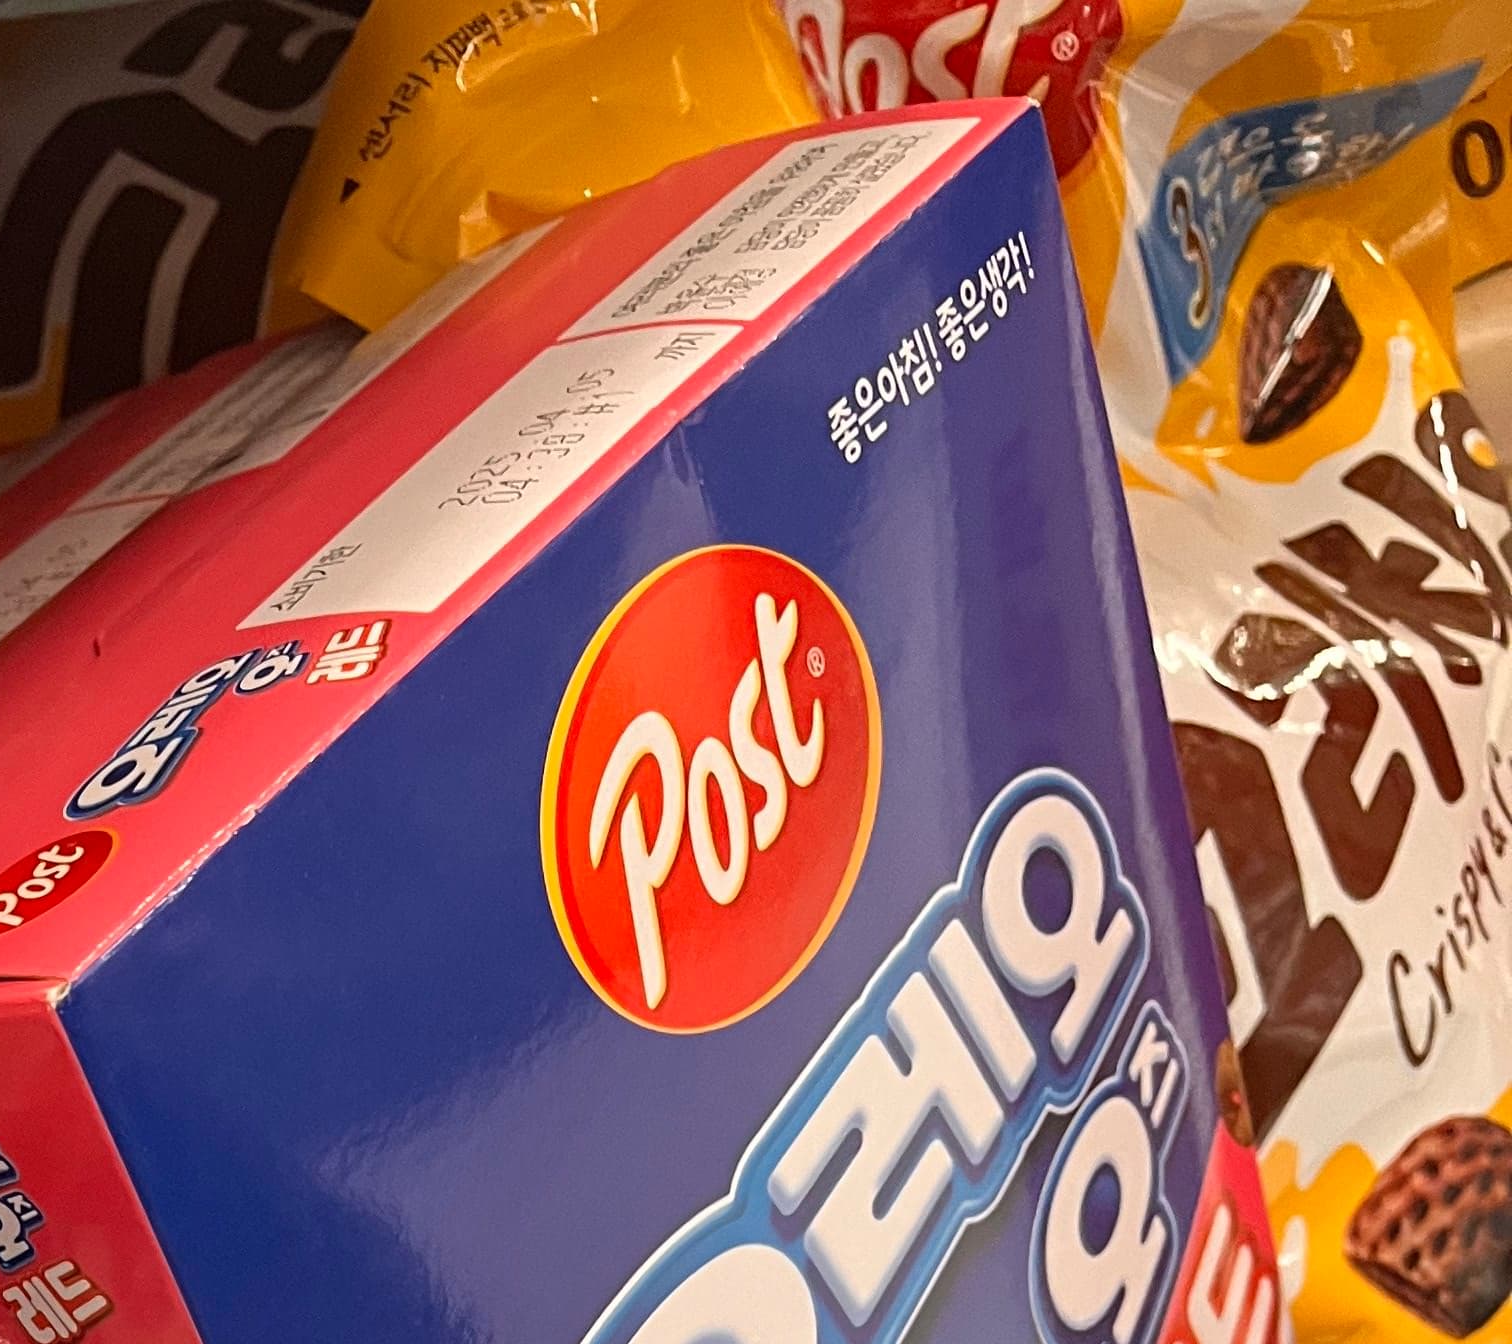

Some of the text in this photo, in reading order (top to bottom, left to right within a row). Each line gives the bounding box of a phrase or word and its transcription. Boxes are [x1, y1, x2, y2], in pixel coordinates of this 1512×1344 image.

[655, 330, 716, 362] 까지
[826, 330, 942, 464] 좋은아침!
[936, 231, 1034, 359] 좋은생각!
[272, 540, 361, 612] 소비기한
[73, 650, 248, 810] 오레오
[306, 618, 388, 684] 레드
[588, 592, 826, 1010] Post
[8, 1262, 106, 1344] 레드
